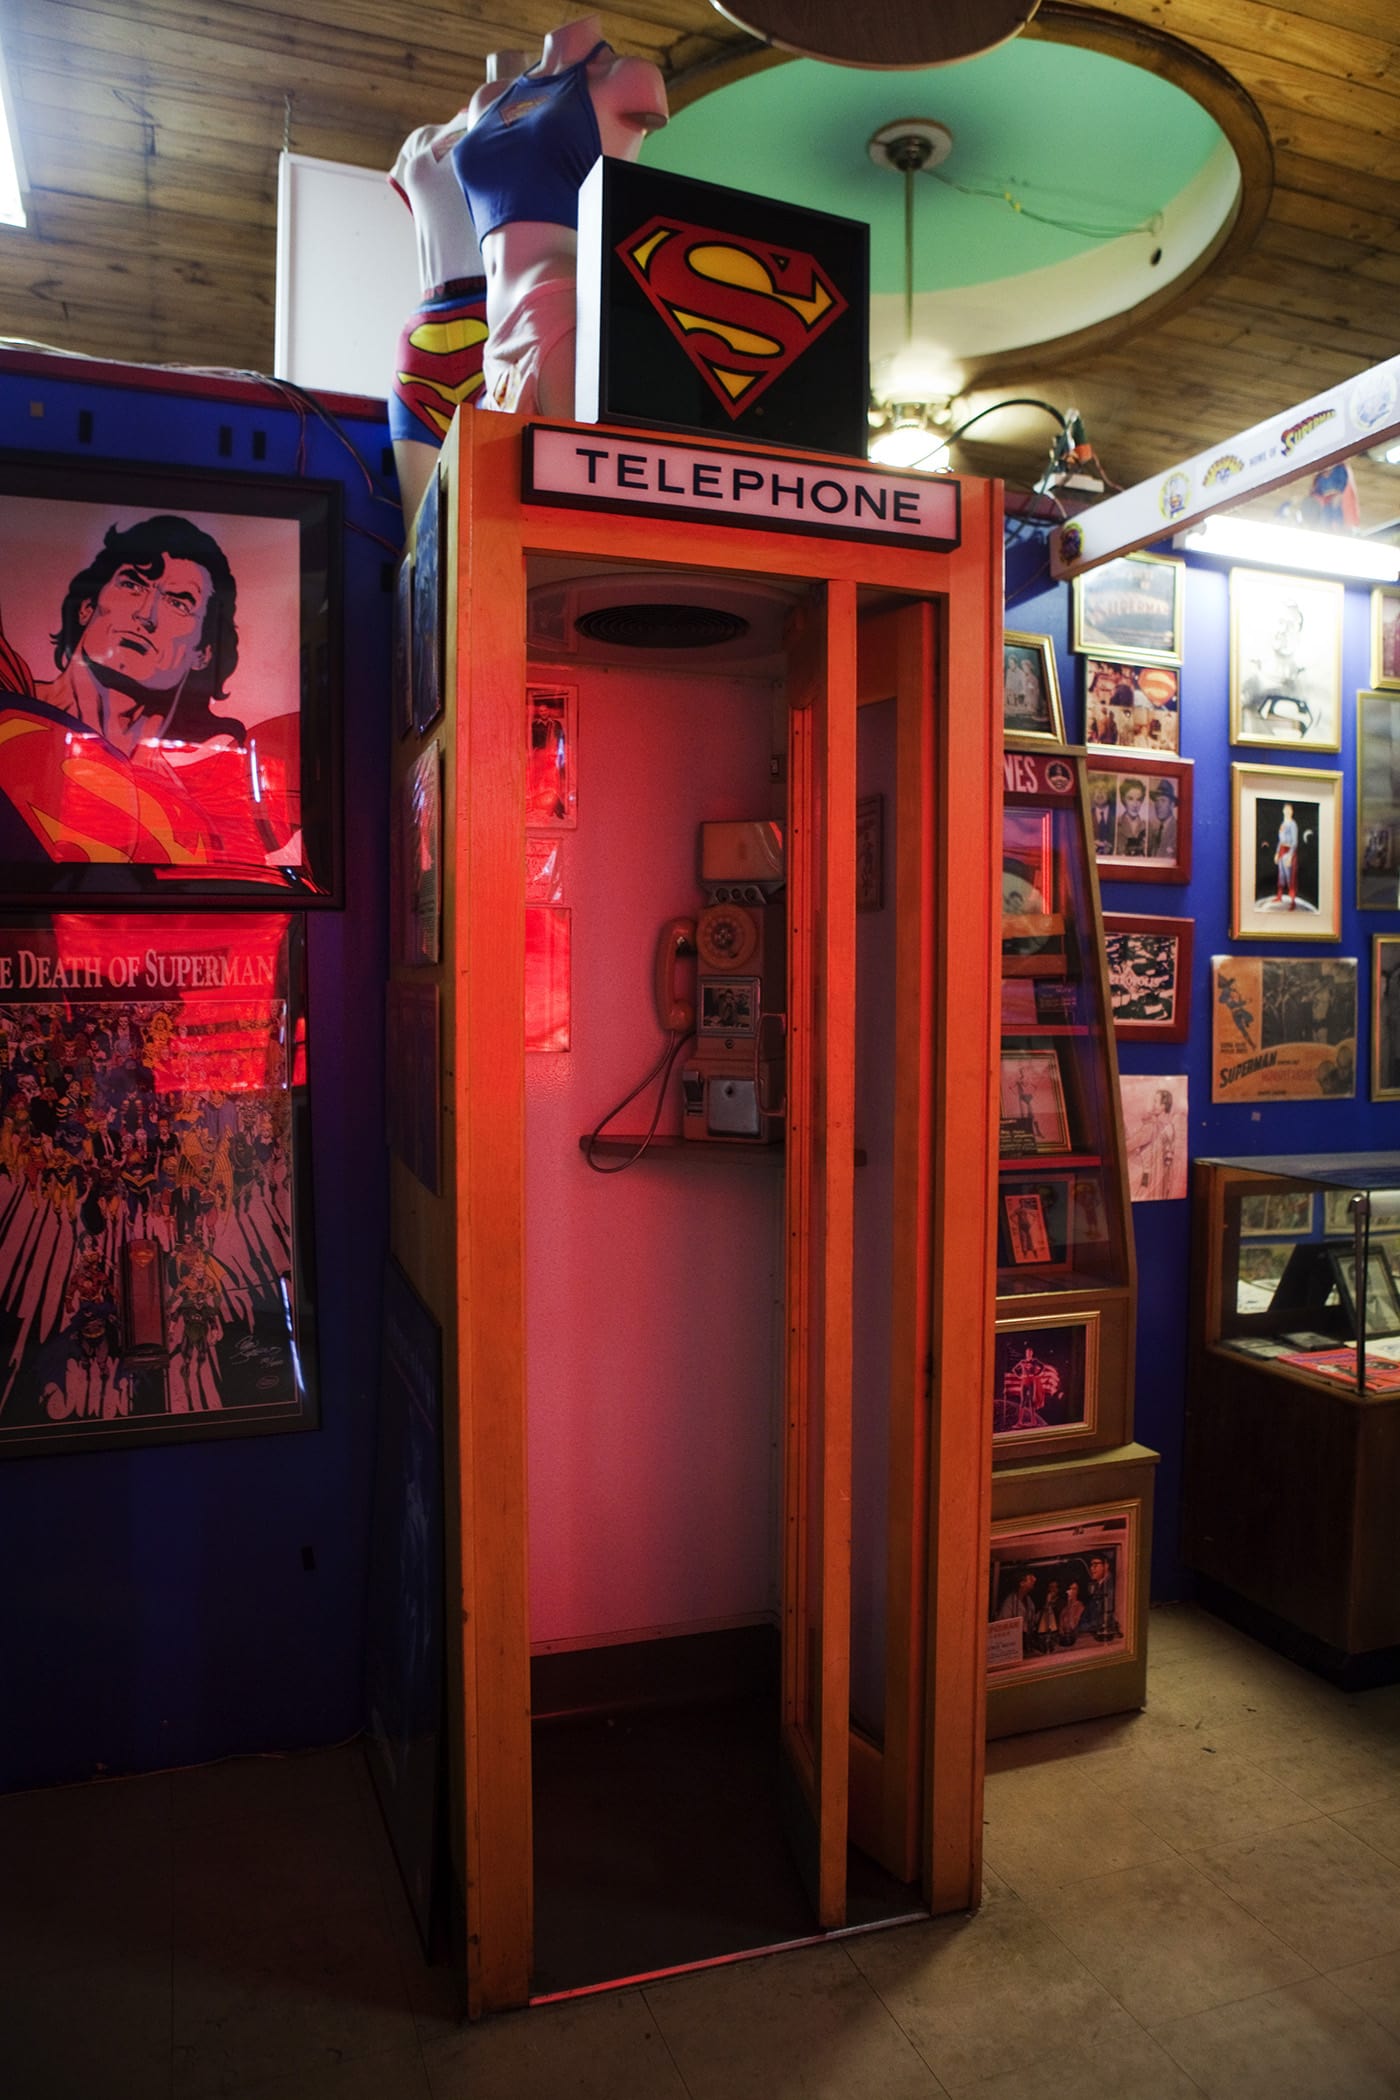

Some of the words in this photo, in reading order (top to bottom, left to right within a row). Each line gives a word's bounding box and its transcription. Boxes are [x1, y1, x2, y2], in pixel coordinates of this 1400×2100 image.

[576, 449, 921, 525] TELEPHONE
[18, 950, 103, 989] DEATH
[108, 956, 141, 988] OF
[145, 948, 275, 988] SUPERMAN
[1219, 1051, 1278, 1089] SUPERMAN
